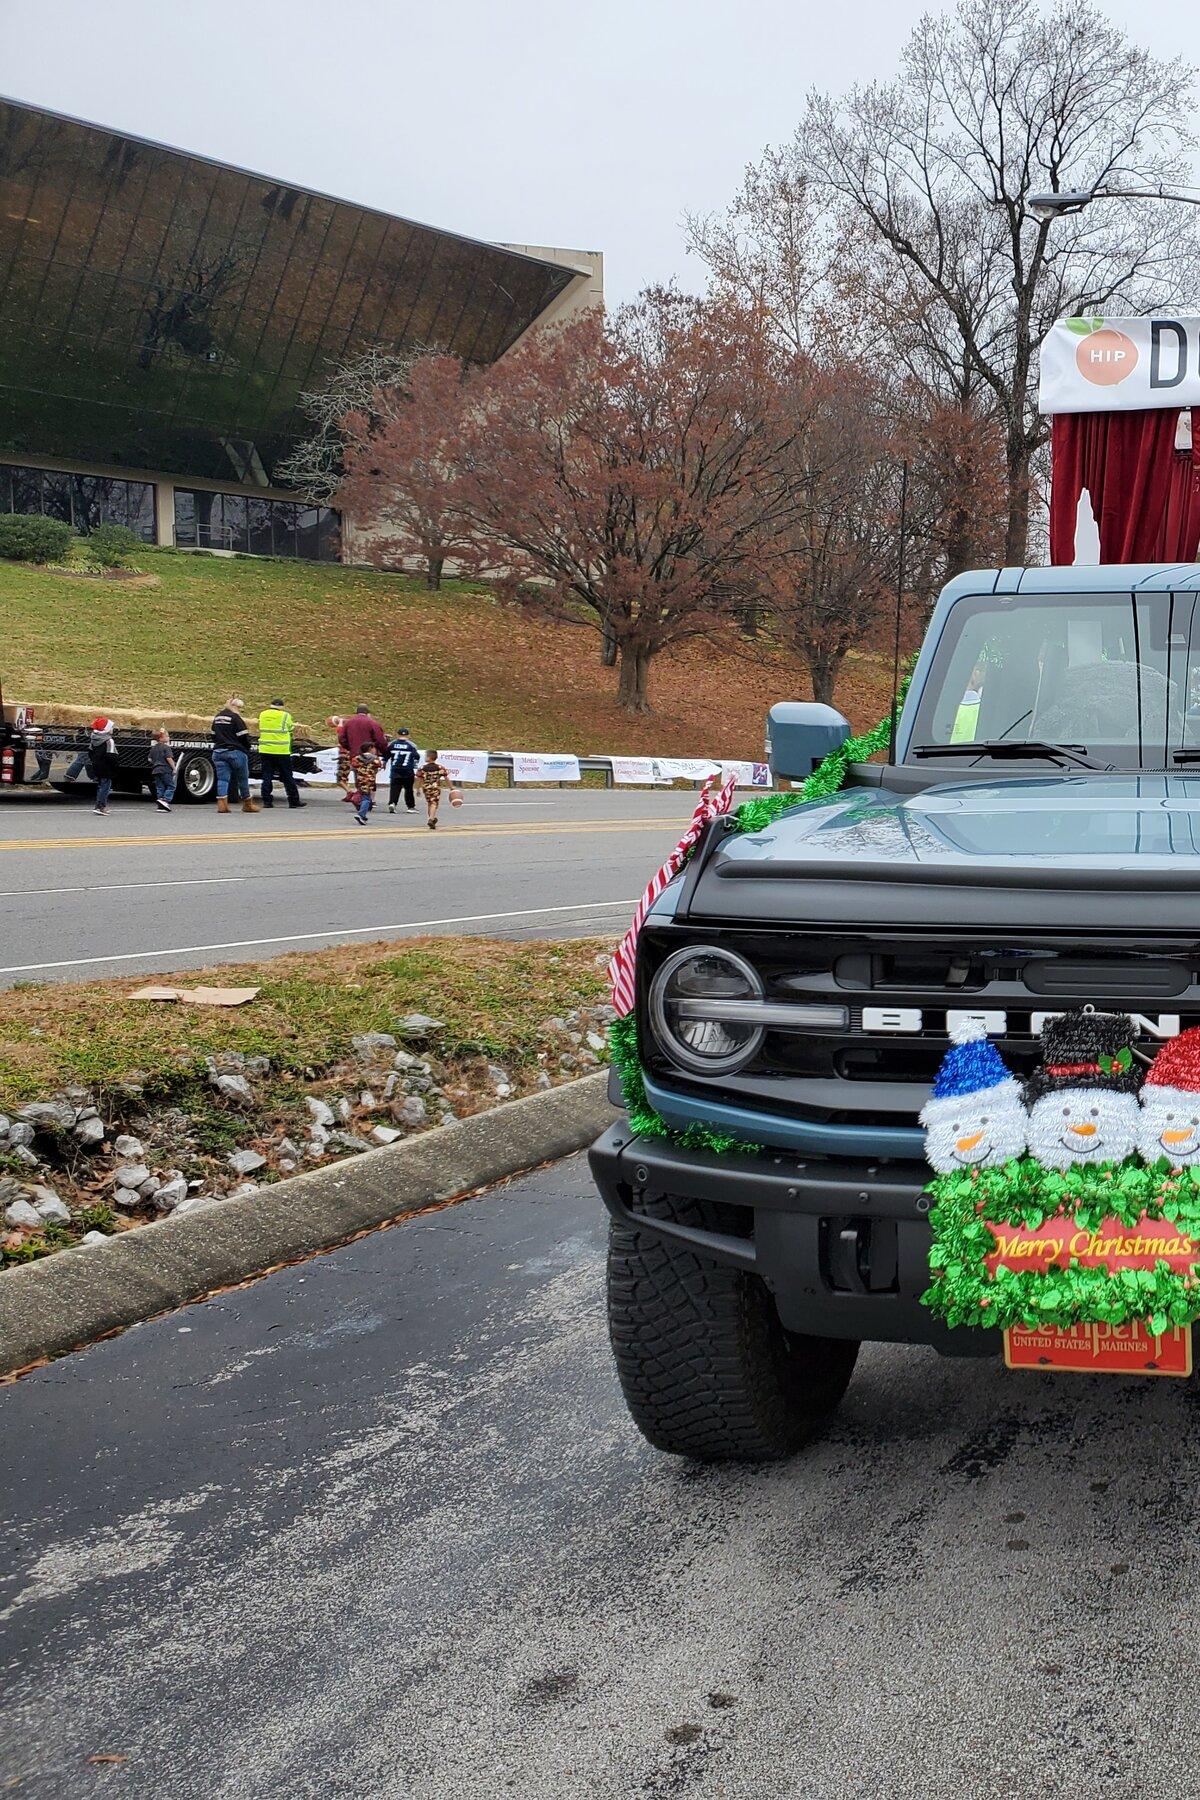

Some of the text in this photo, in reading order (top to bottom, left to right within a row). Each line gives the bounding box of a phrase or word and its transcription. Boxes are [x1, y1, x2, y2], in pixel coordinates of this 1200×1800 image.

[1091, 349, 1127, 363] HIP
[390, 750, 412, 767] 77
[989, 1231, 1193, 1263] Merry Christmas
[1013, 1336, 1148, 1352] UNITED STATES MARINES
